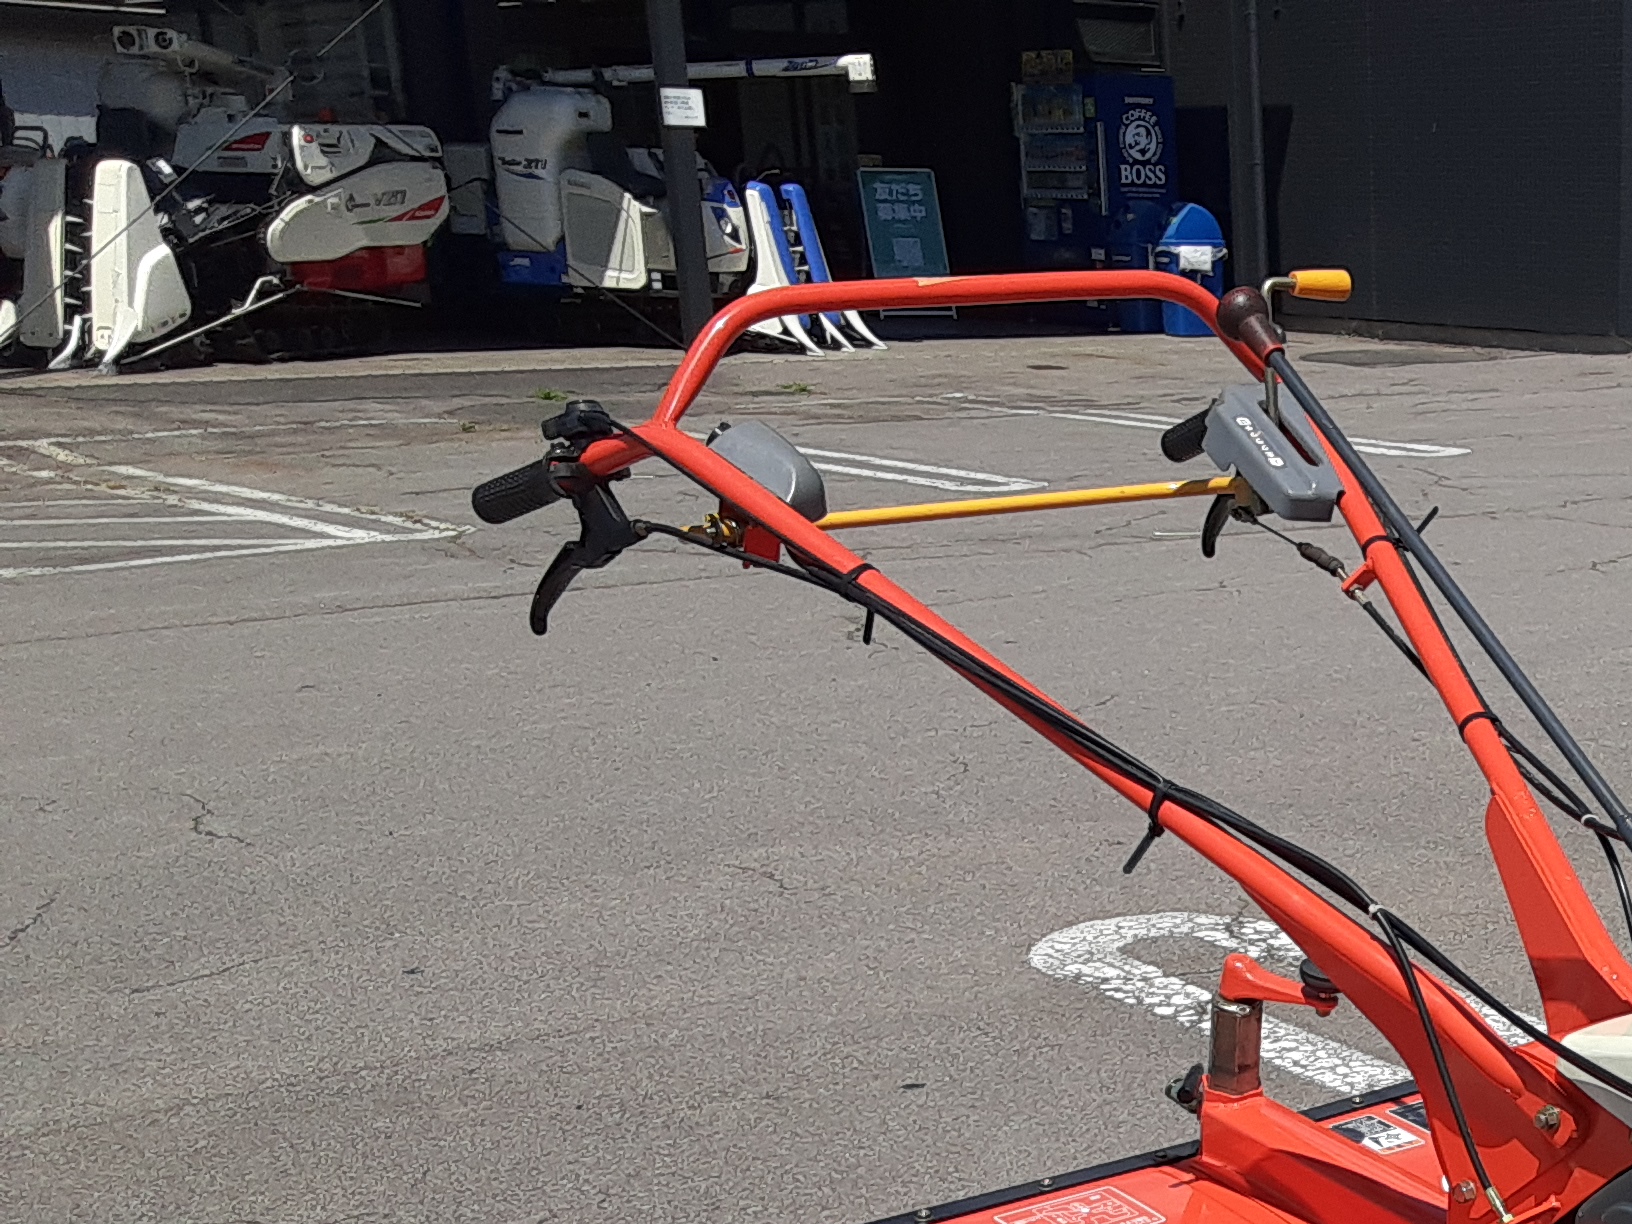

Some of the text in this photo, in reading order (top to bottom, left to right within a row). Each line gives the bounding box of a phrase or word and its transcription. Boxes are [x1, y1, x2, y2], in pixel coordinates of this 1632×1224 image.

[1122, 108, 1158, 126] COFFEE
[1119, 164, 1166, 185] BOSS
[873, 182, 924, 202] 友だち
